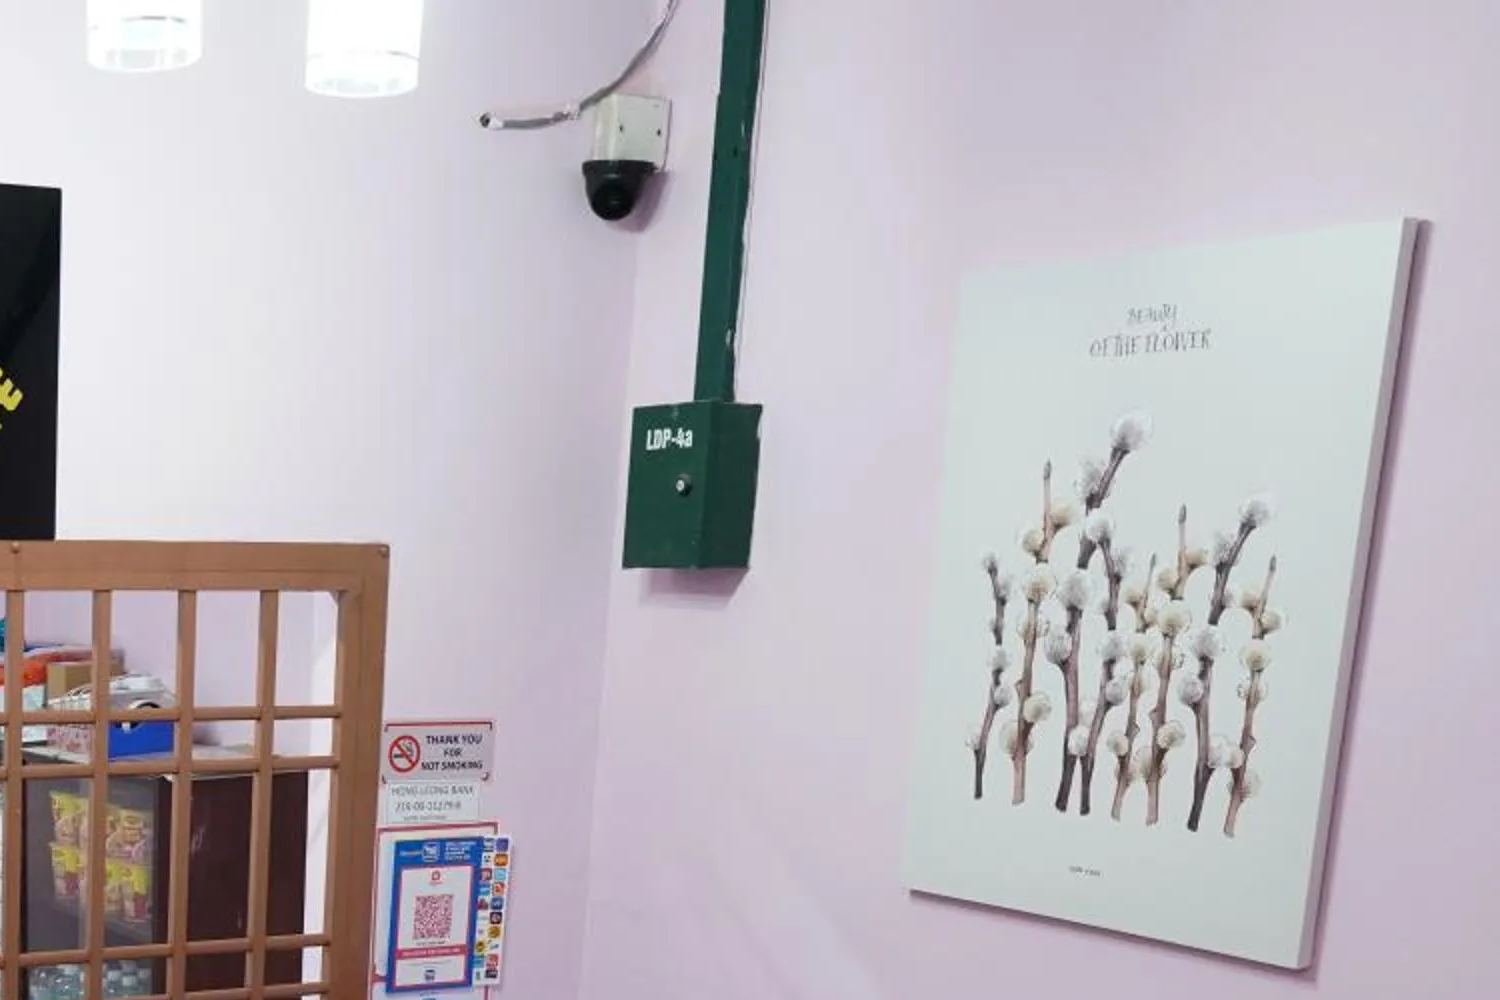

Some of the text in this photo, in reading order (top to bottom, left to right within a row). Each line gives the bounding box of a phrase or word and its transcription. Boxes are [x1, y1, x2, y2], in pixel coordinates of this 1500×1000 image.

[425, 734, 483, 745] THANK YOU
[443, 748, 462, 757] FOR
[421, 760, 483, 771] NOT SMOKING
